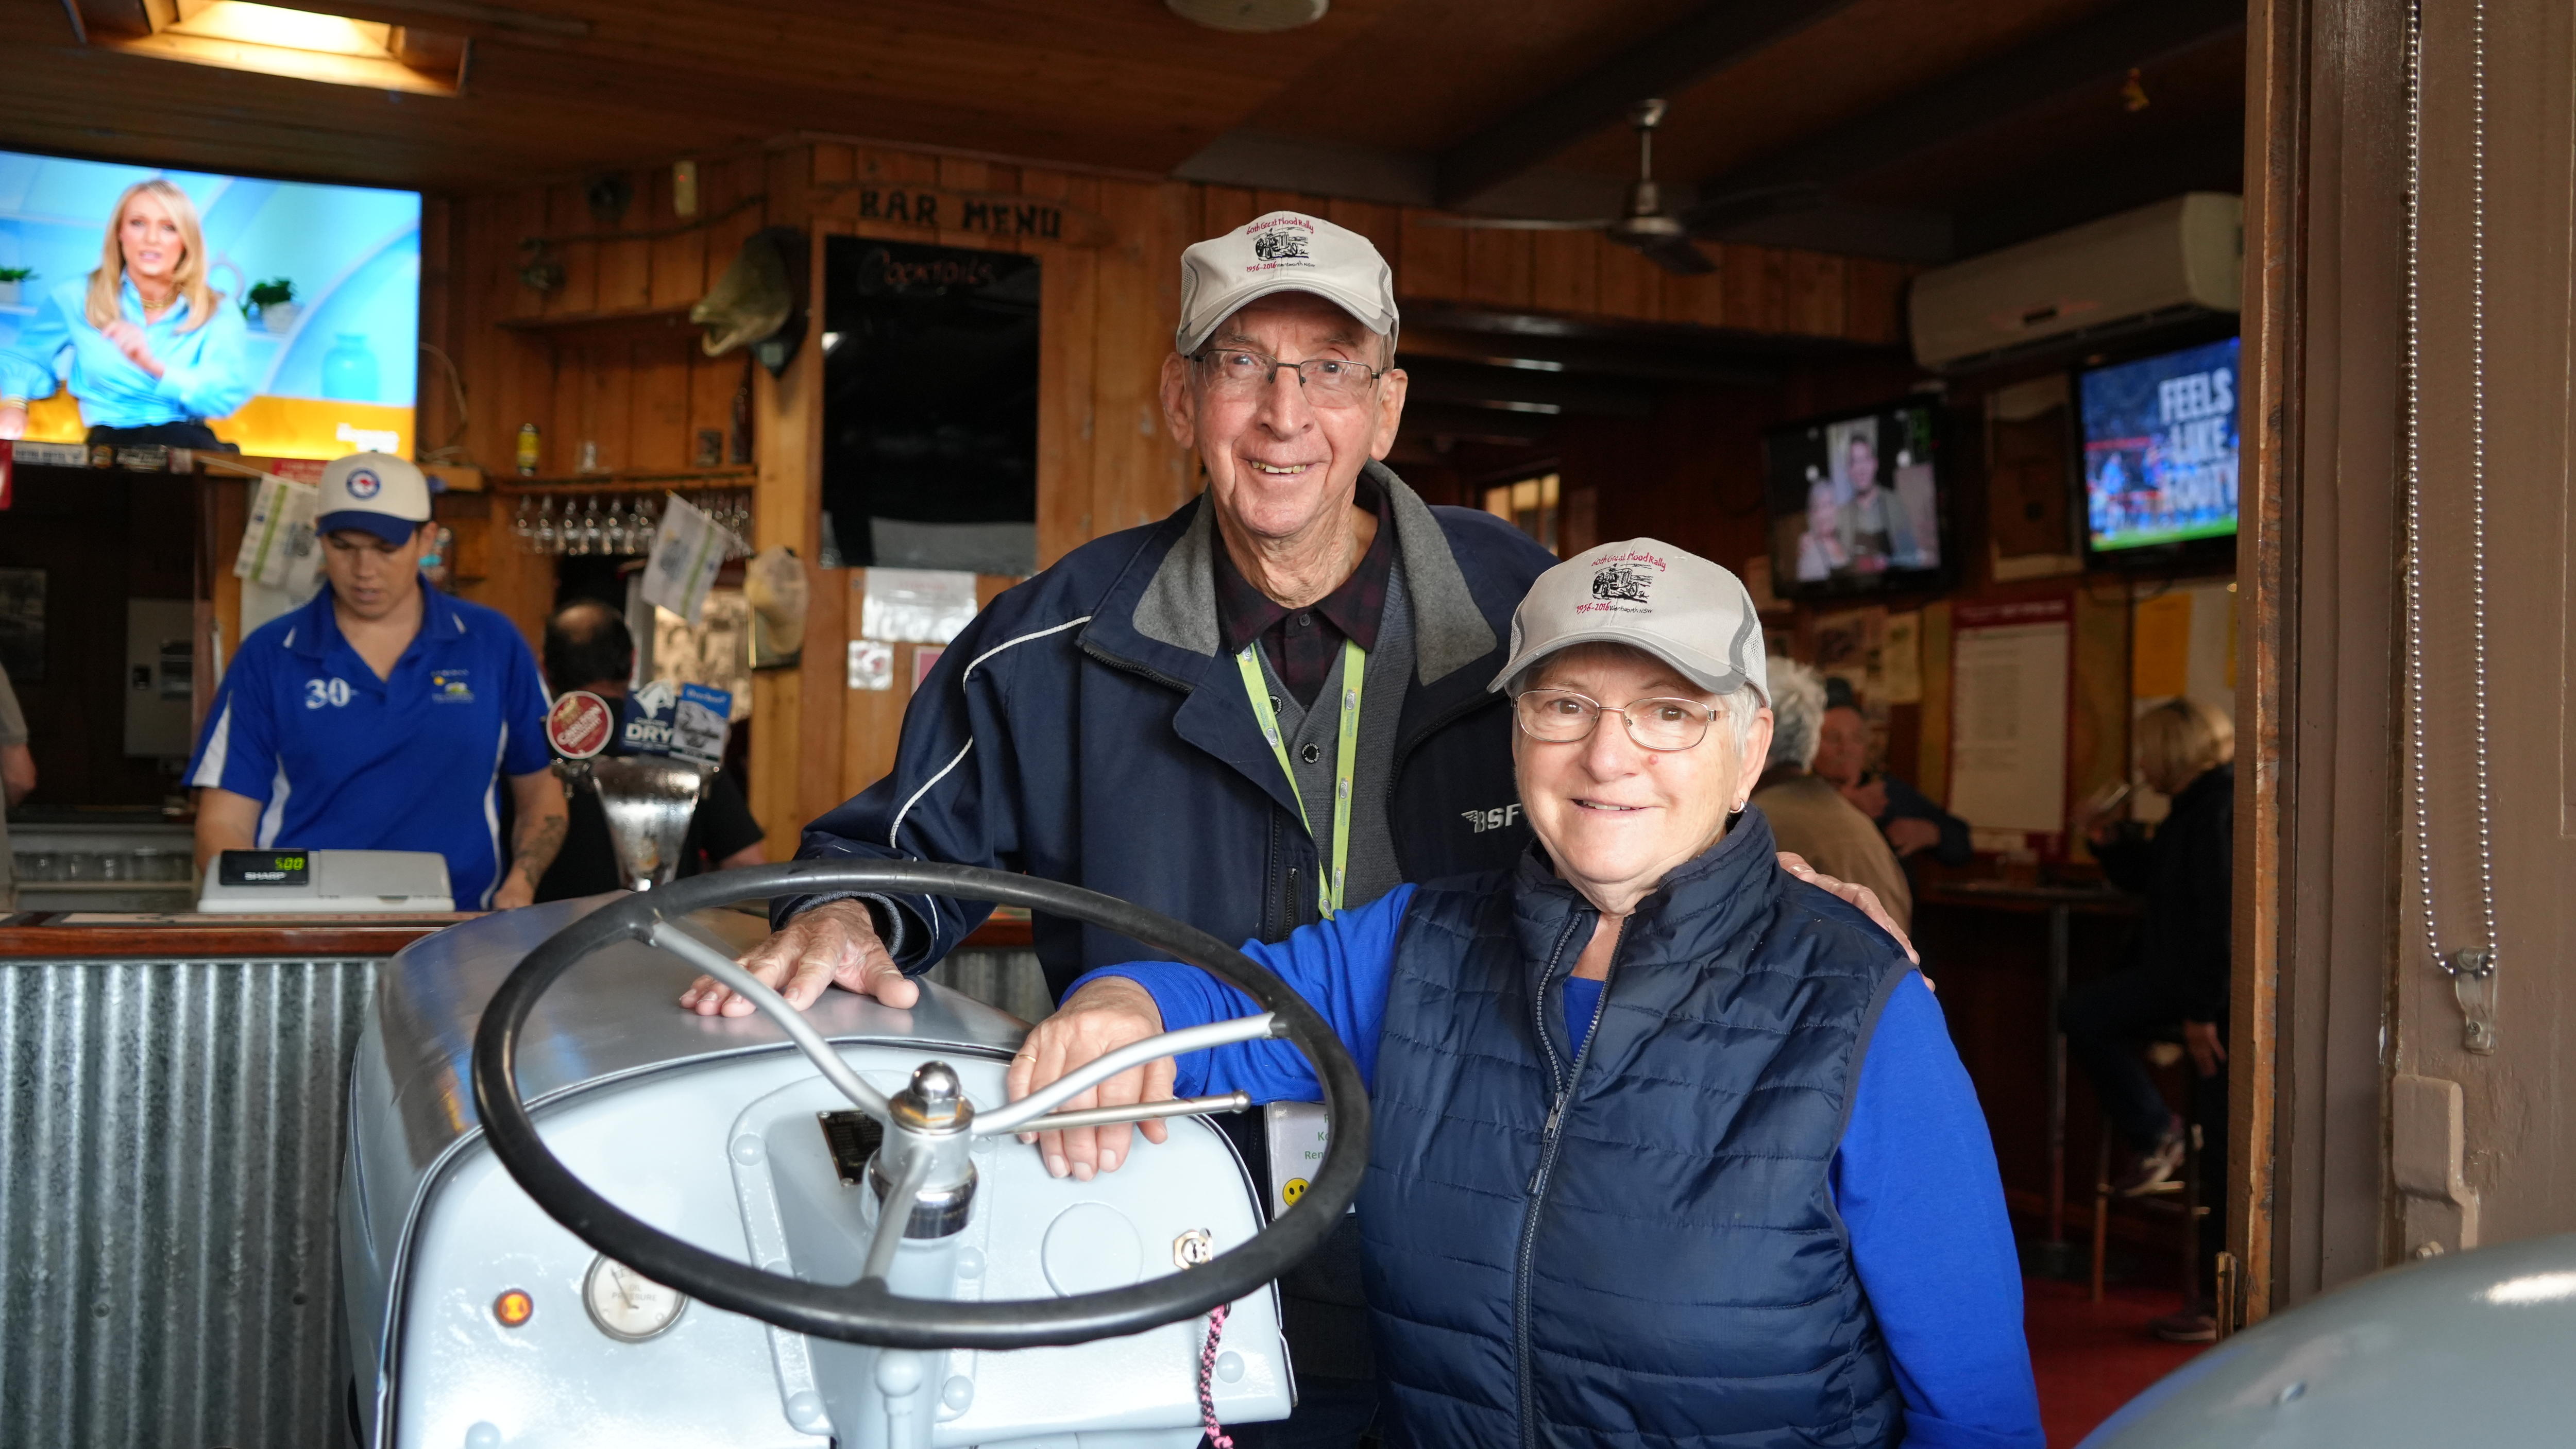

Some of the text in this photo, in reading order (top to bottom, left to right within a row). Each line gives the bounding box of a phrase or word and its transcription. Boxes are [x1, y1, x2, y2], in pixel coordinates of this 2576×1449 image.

[859, 190, 1062, 238] BAR MENU
[1246, 217, 1314, 235] 60th Great Flood Rally
[2158, 367, 2235, 427] FEELS
[2170, 415, 2229, 463] LIKE
[1591, 551, 1667, 572] 60th Great Flood Rally
[625, 722, 673, 742] DRY
[244, 872, 287, 880] SHARP
[1305, 1151, 1324, 1160] Ren
